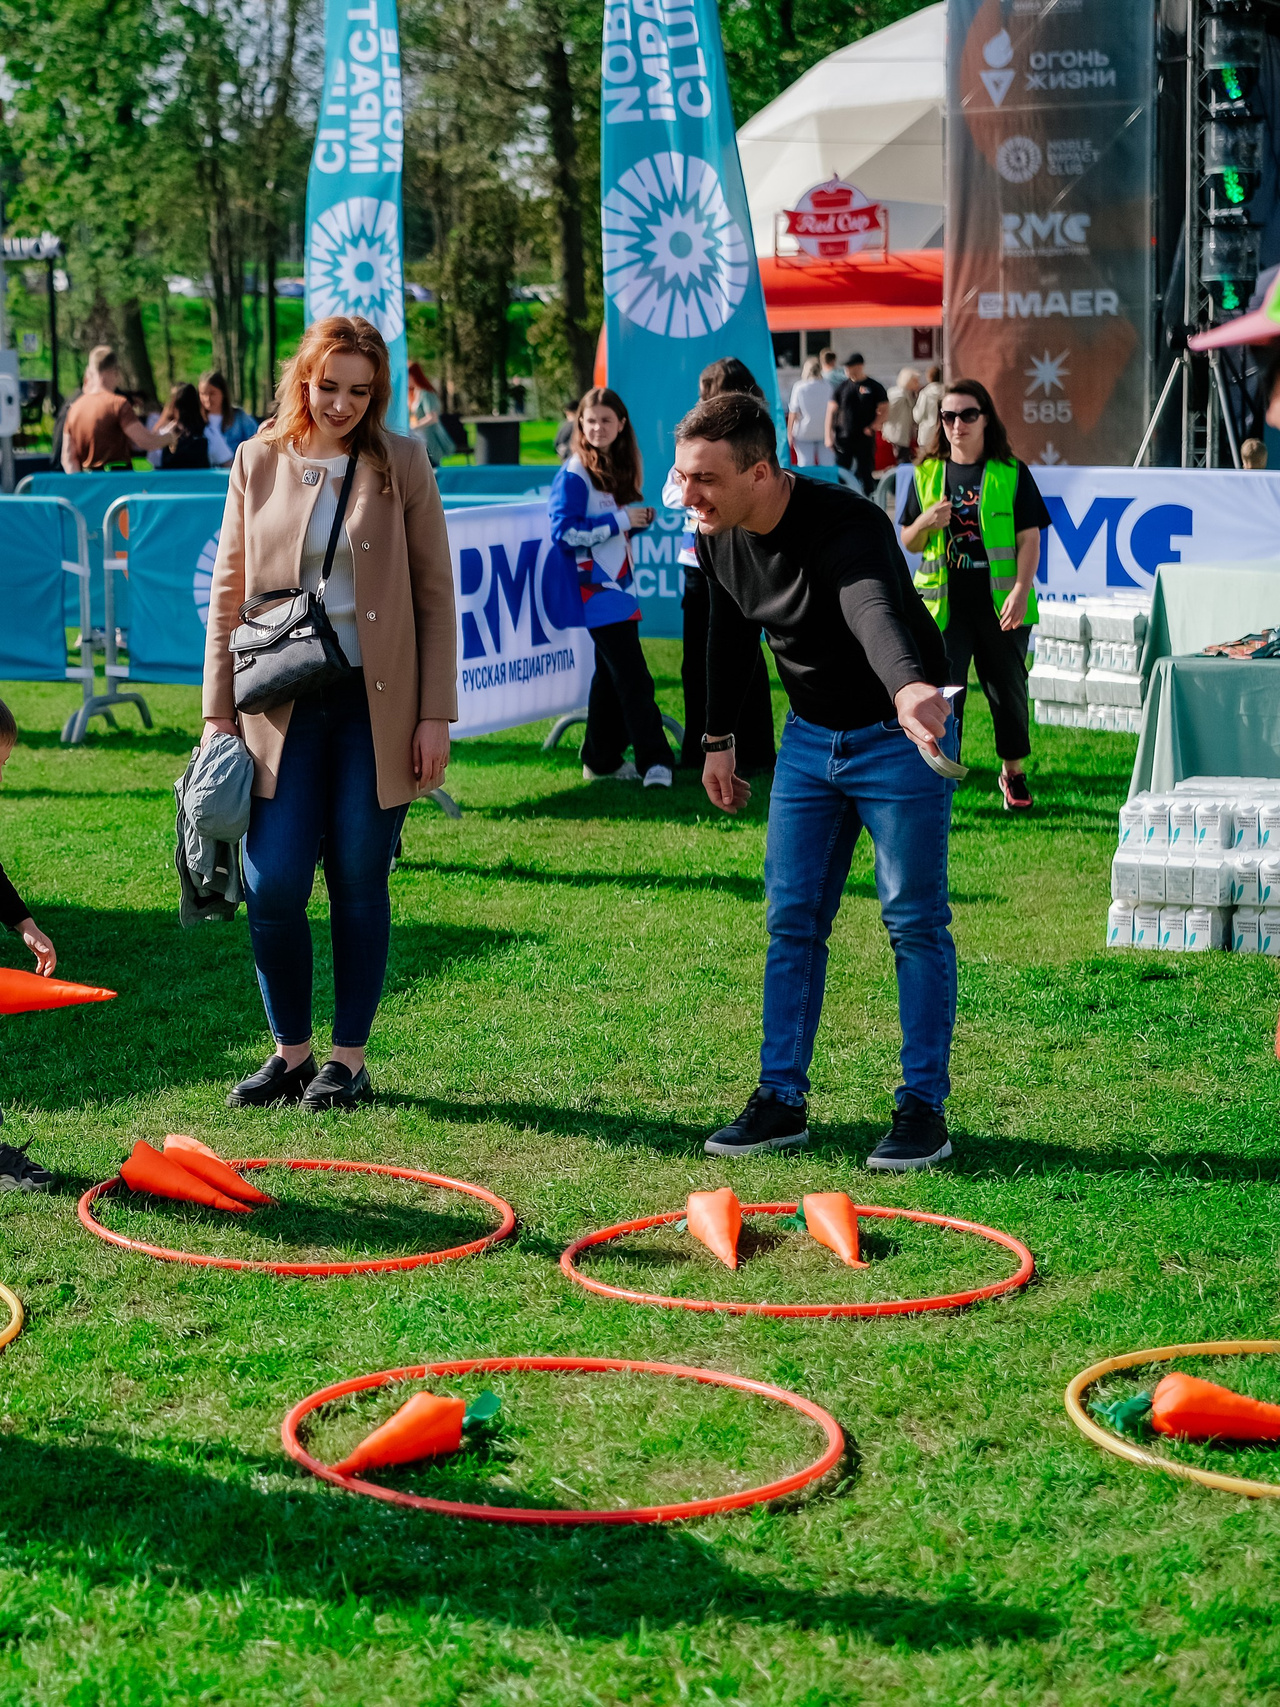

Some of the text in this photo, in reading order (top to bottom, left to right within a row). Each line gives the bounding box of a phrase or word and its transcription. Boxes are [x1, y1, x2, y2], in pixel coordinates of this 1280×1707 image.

[1029, 49, 1110, 71] ОГОНЬ
[1025, 69, 1117, 91] ЖИЗНИ
[1006, 288, 1119, 319] MAER
[1022, 402, 1073, 424] 585
[462, 648, 576, 692] РУССКАЯ МЕДИАГРУППА
